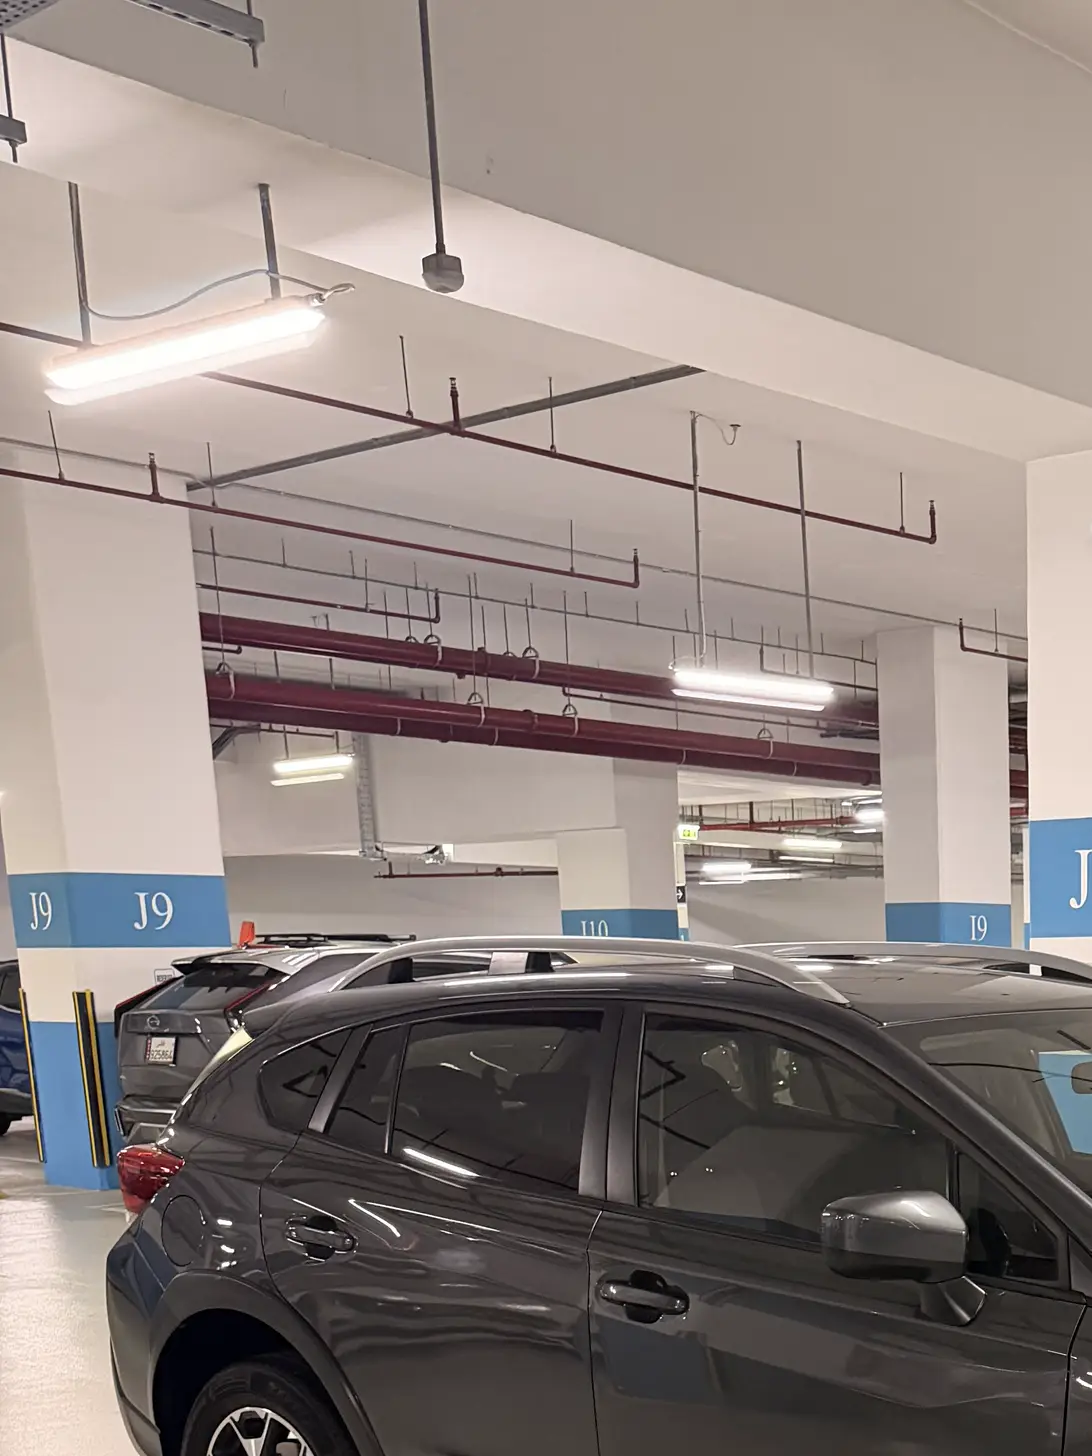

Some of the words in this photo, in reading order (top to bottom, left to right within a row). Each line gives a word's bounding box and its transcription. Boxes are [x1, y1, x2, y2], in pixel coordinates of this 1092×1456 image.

[29, 891, 53, 931] J9
[133, 891, 174, 931] J9
[970, 915, 989, 941] I9
